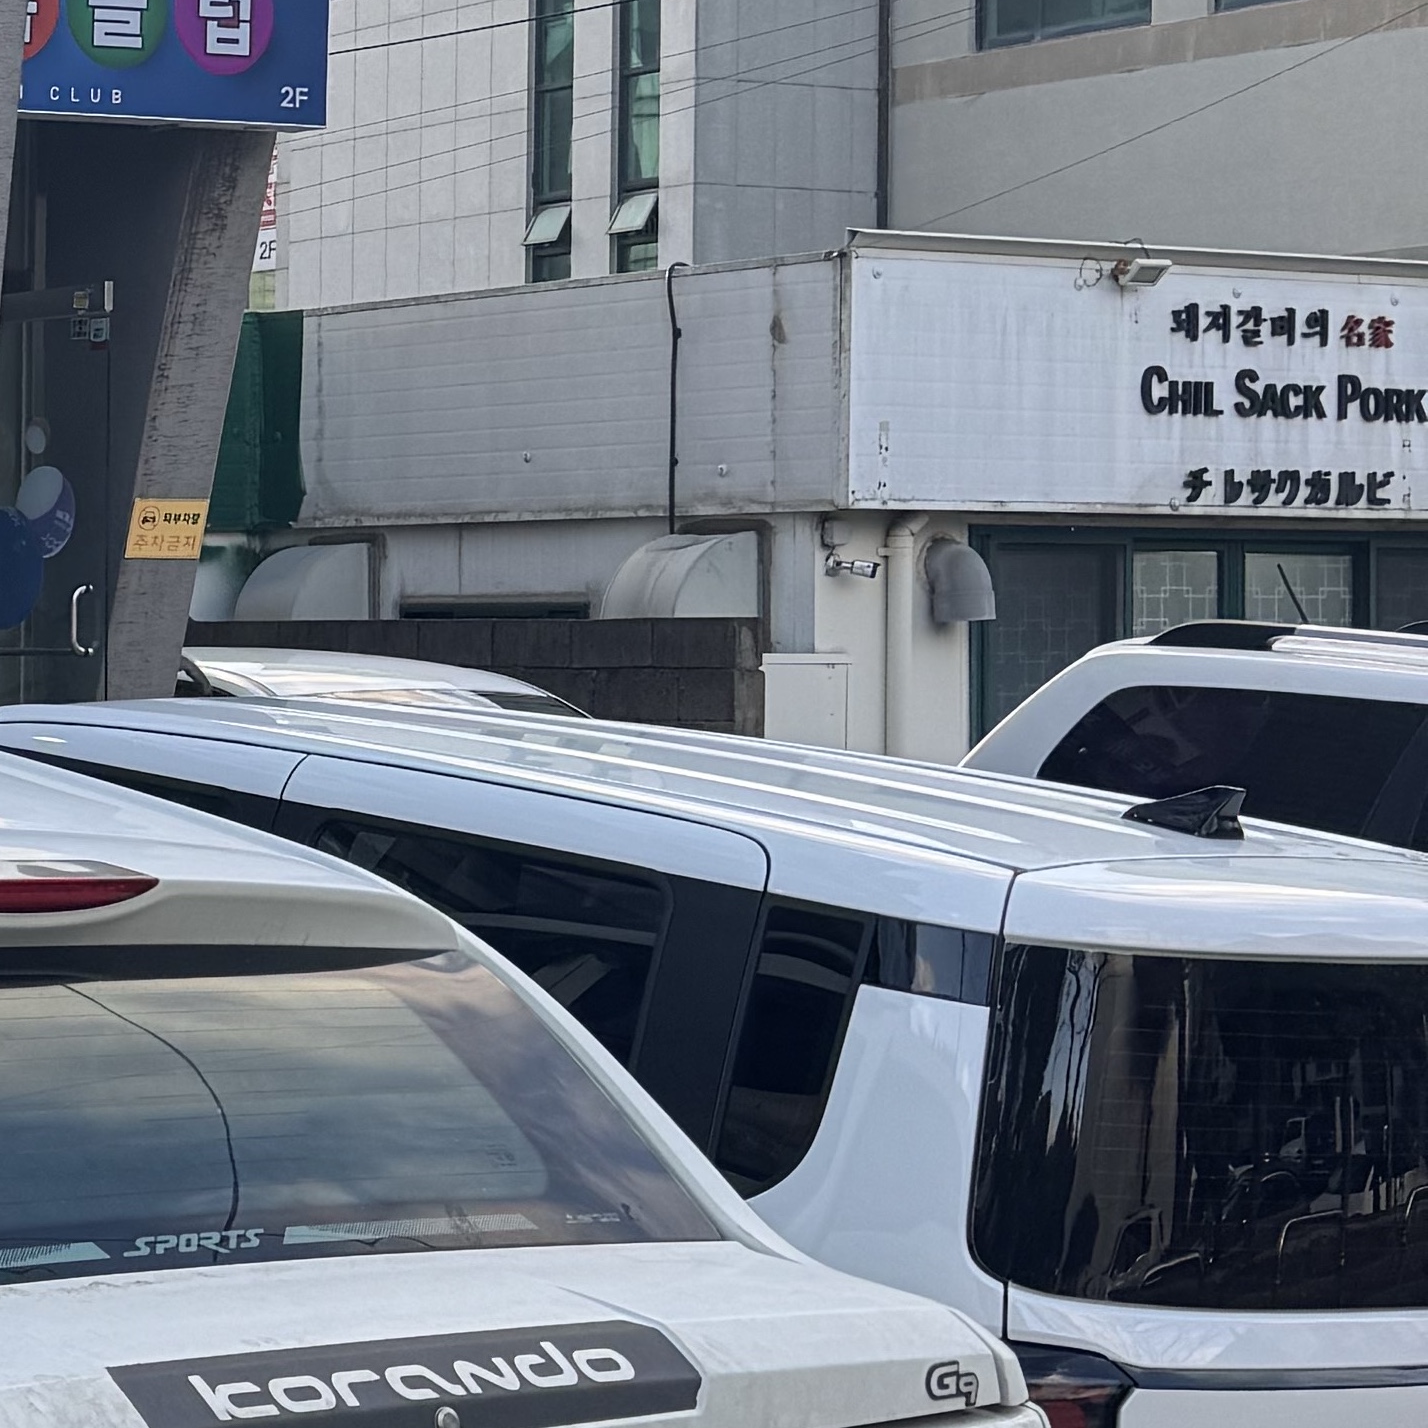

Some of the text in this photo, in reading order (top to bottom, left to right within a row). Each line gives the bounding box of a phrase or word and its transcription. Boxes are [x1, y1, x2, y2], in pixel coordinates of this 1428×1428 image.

[50, 87, 123, 105] CLUB
[280, 86, 309, 108] 2F
[133, 534, 197, 552] 주차금지
[123, 1228, 264, 1257] SPORTS
[188, 1340, 636, 1422] korando
